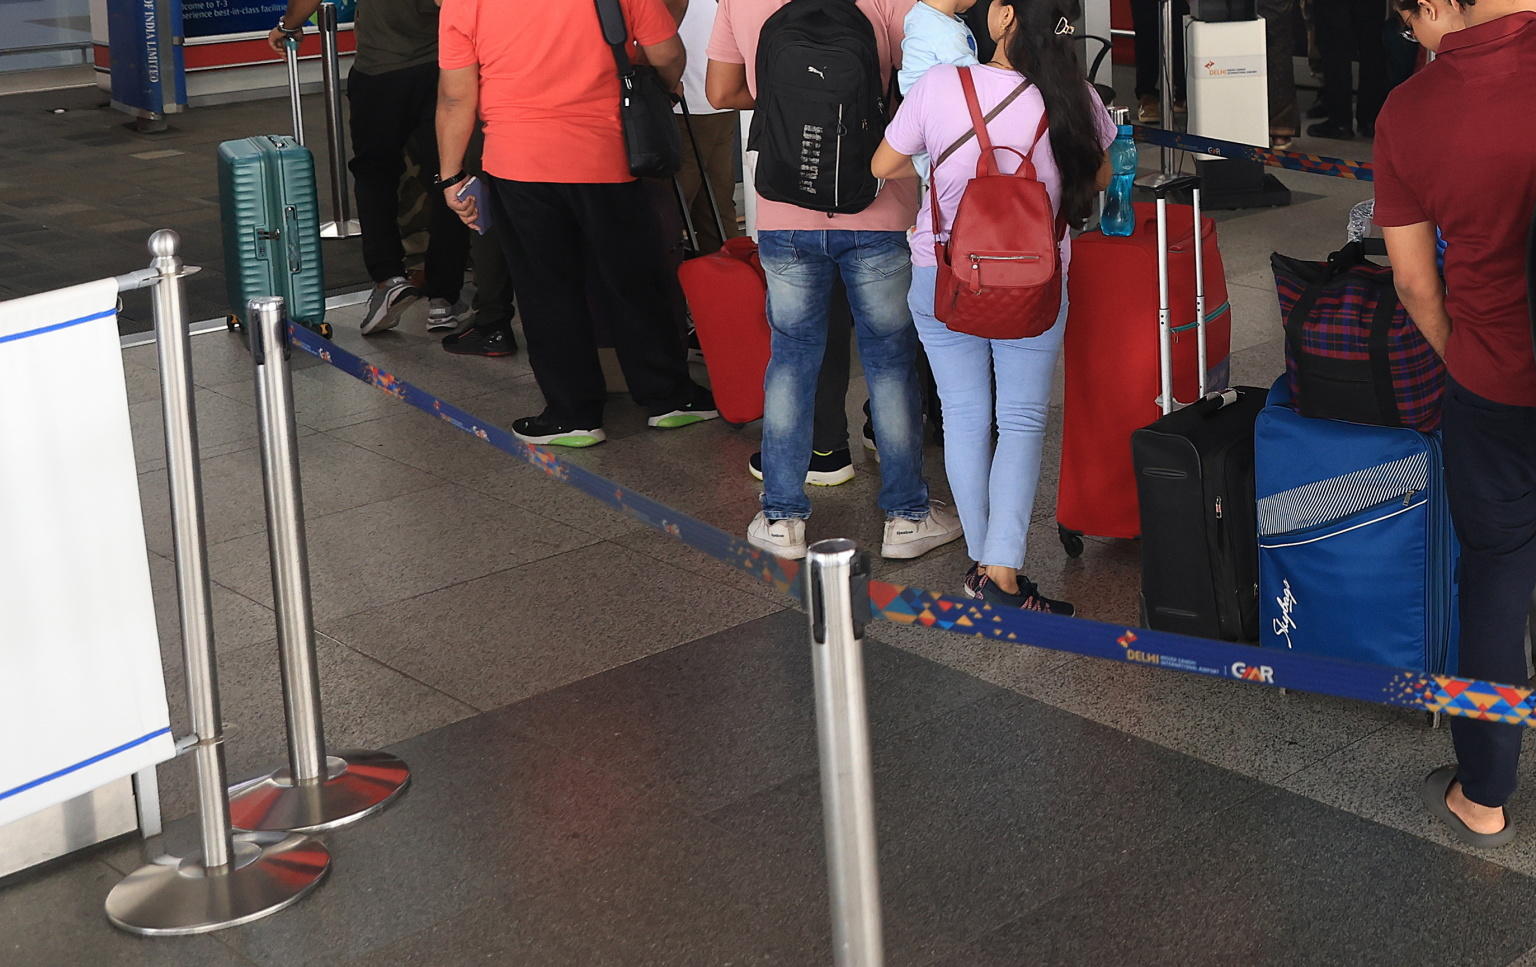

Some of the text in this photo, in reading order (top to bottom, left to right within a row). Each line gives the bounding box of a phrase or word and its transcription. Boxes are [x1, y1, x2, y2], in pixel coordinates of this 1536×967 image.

[182, 2, 205, 11] come
[206, 0, 215, 9] to
[182, 4, 287, 20] perience best-in-class facilitie
[145, 11, 158, 41] INDIA
[146, 39, 160, 83] LIMITED
[1273, 577, 1297, 649] Skybags
[1126, 649, 1160, 665] DELHI
[1231, 661, 1274, 684] GMR
